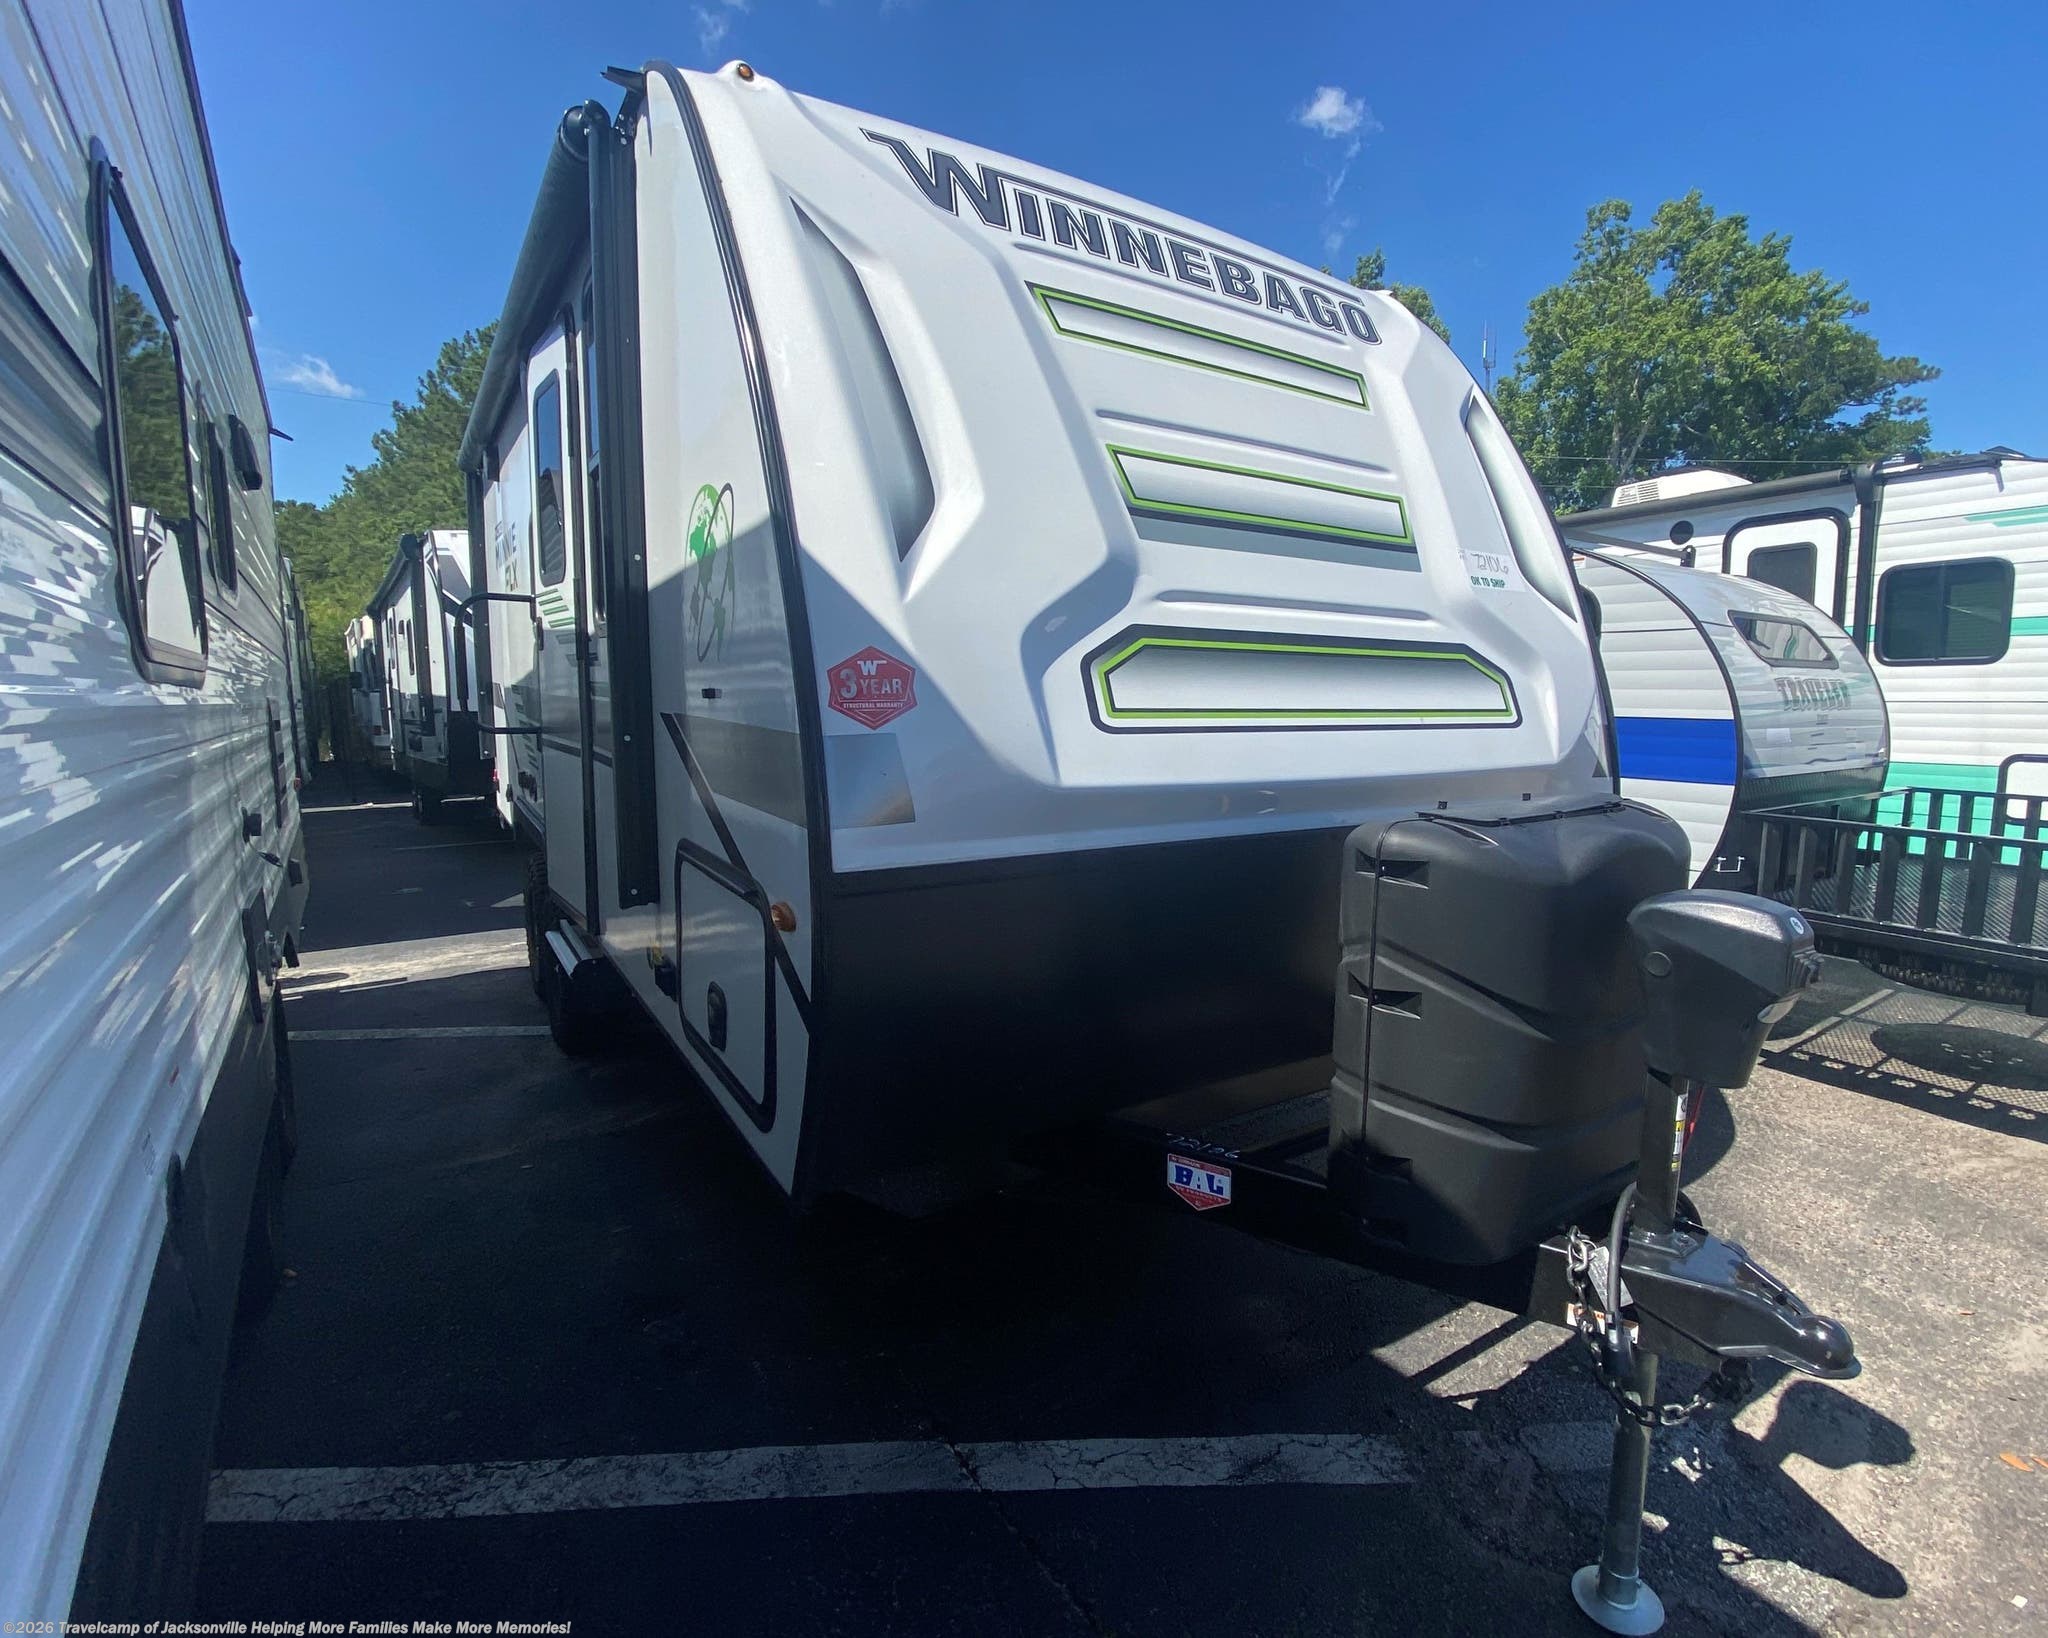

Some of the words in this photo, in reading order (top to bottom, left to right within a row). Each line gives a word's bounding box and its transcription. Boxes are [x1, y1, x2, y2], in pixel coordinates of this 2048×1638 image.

[859, 127, 1383, 345] WINNEBAGO
[1470, 576, 1481, 585] OK
[1481, 577, 1490, 587] TO
[1490, 579, 1505, 588] SHIP
[839, 668, 857, 699] 3
[860, 678, 902, 695] YEAR
